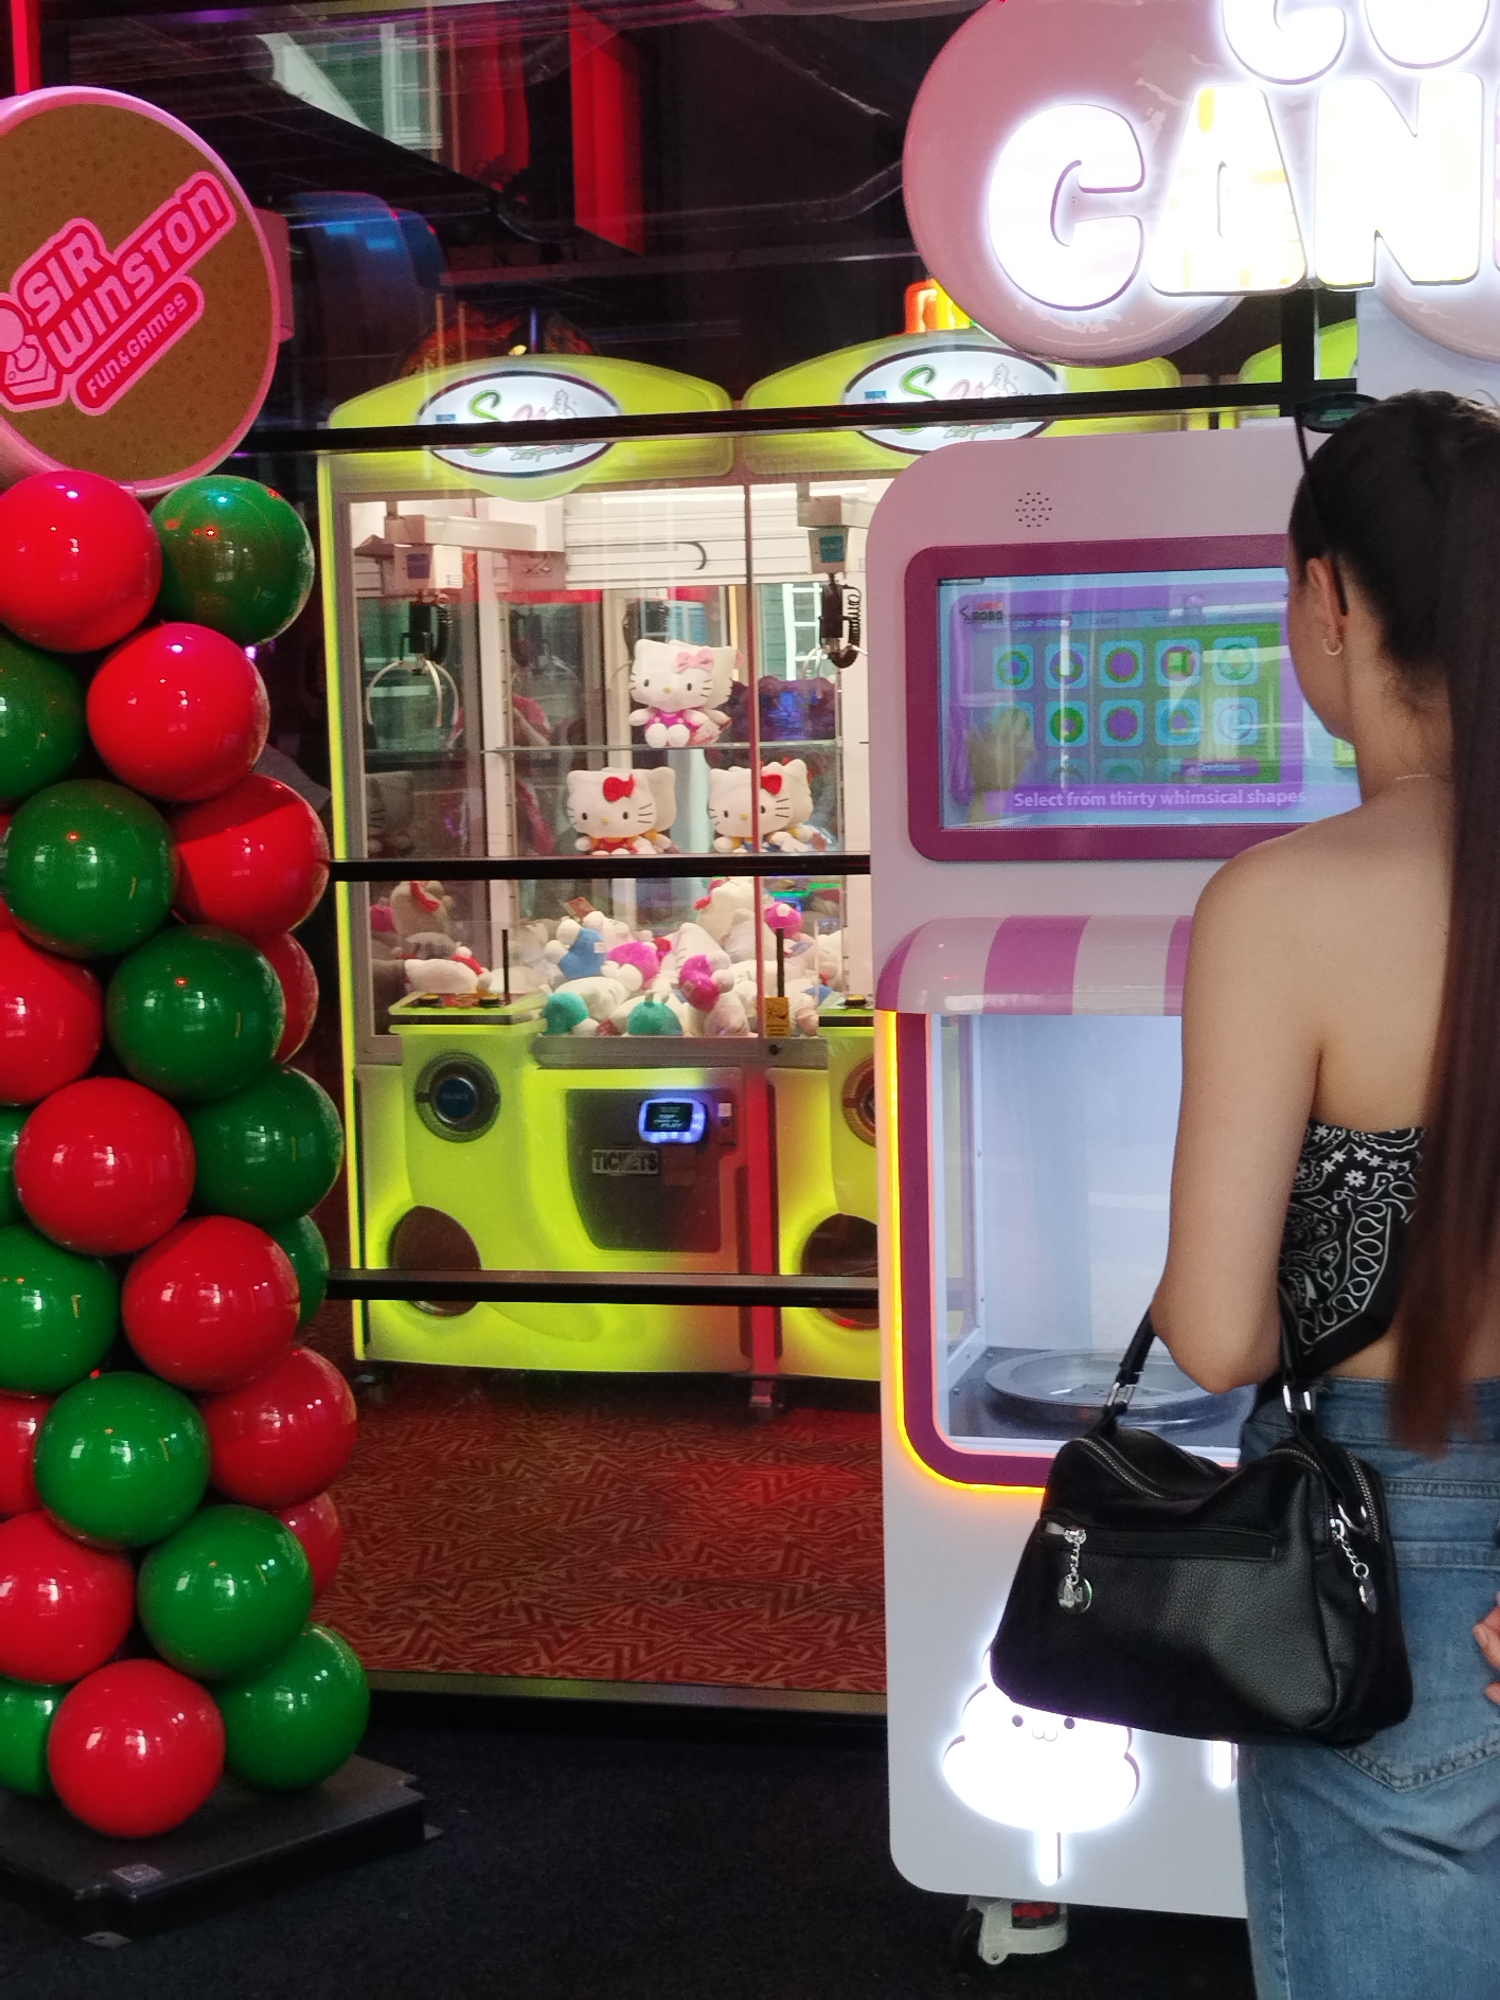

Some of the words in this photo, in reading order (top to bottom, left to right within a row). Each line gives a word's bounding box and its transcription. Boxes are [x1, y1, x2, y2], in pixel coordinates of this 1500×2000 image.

[988, 72, 1500, 310] CAN
[22, 230, 103, 327] SIR
[1013, 791, 1065, 808] Select
[1067, 791, 1107, 806] from
[1109, 791, 1156, 809] thirty
[1160, 788, 1243, 805] whimsical
[1247, 788, 1307, 806] shapes
